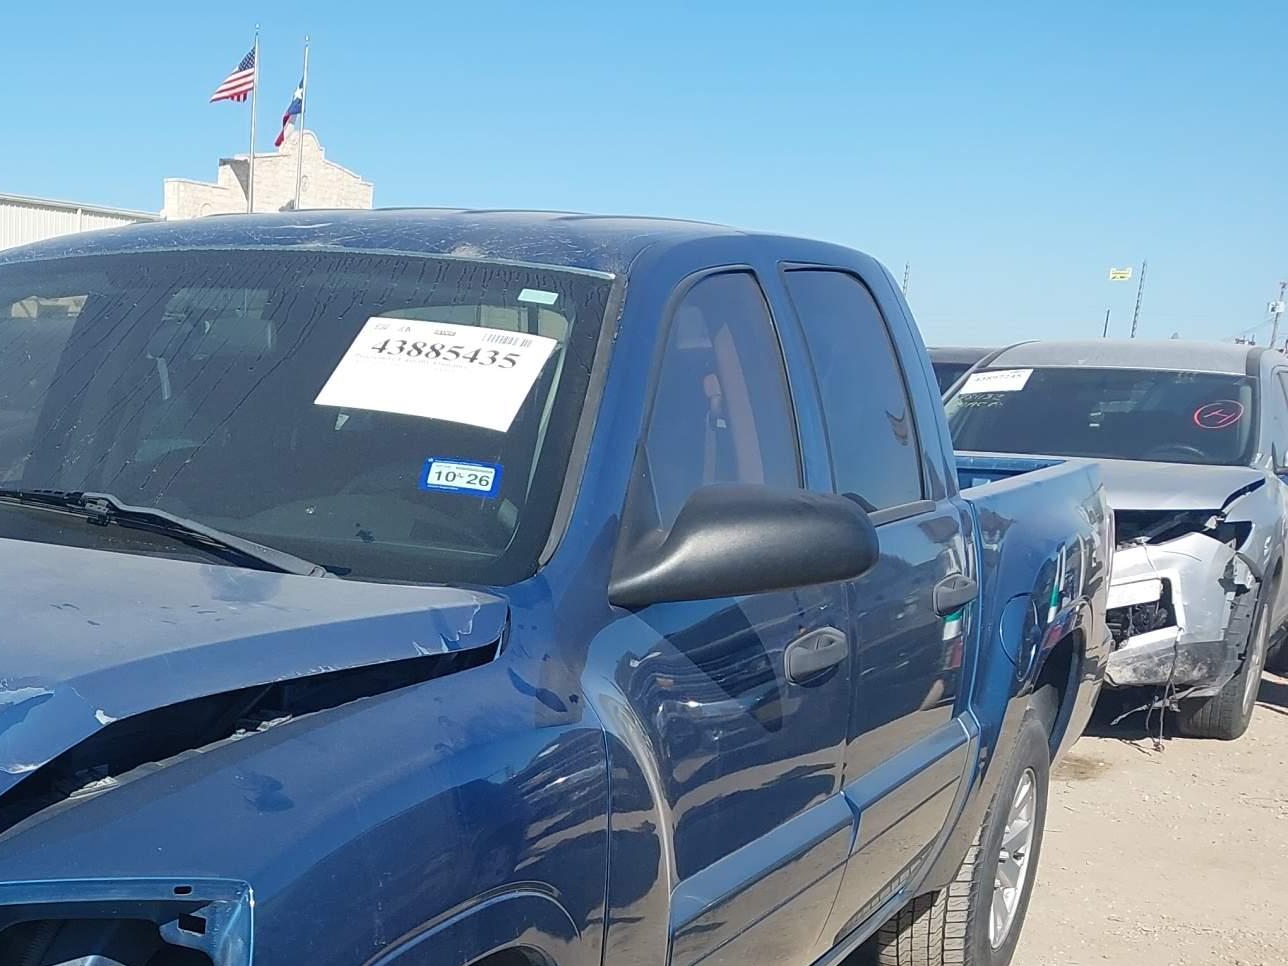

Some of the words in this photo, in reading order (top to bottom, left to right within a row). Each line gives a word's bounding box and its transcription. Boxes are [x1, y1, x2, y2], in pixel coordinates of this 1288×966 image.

[370, 338, 521, 369] 43885435
[434, 470, 457, 483] 10
[465, 473, 491, 487] 26
